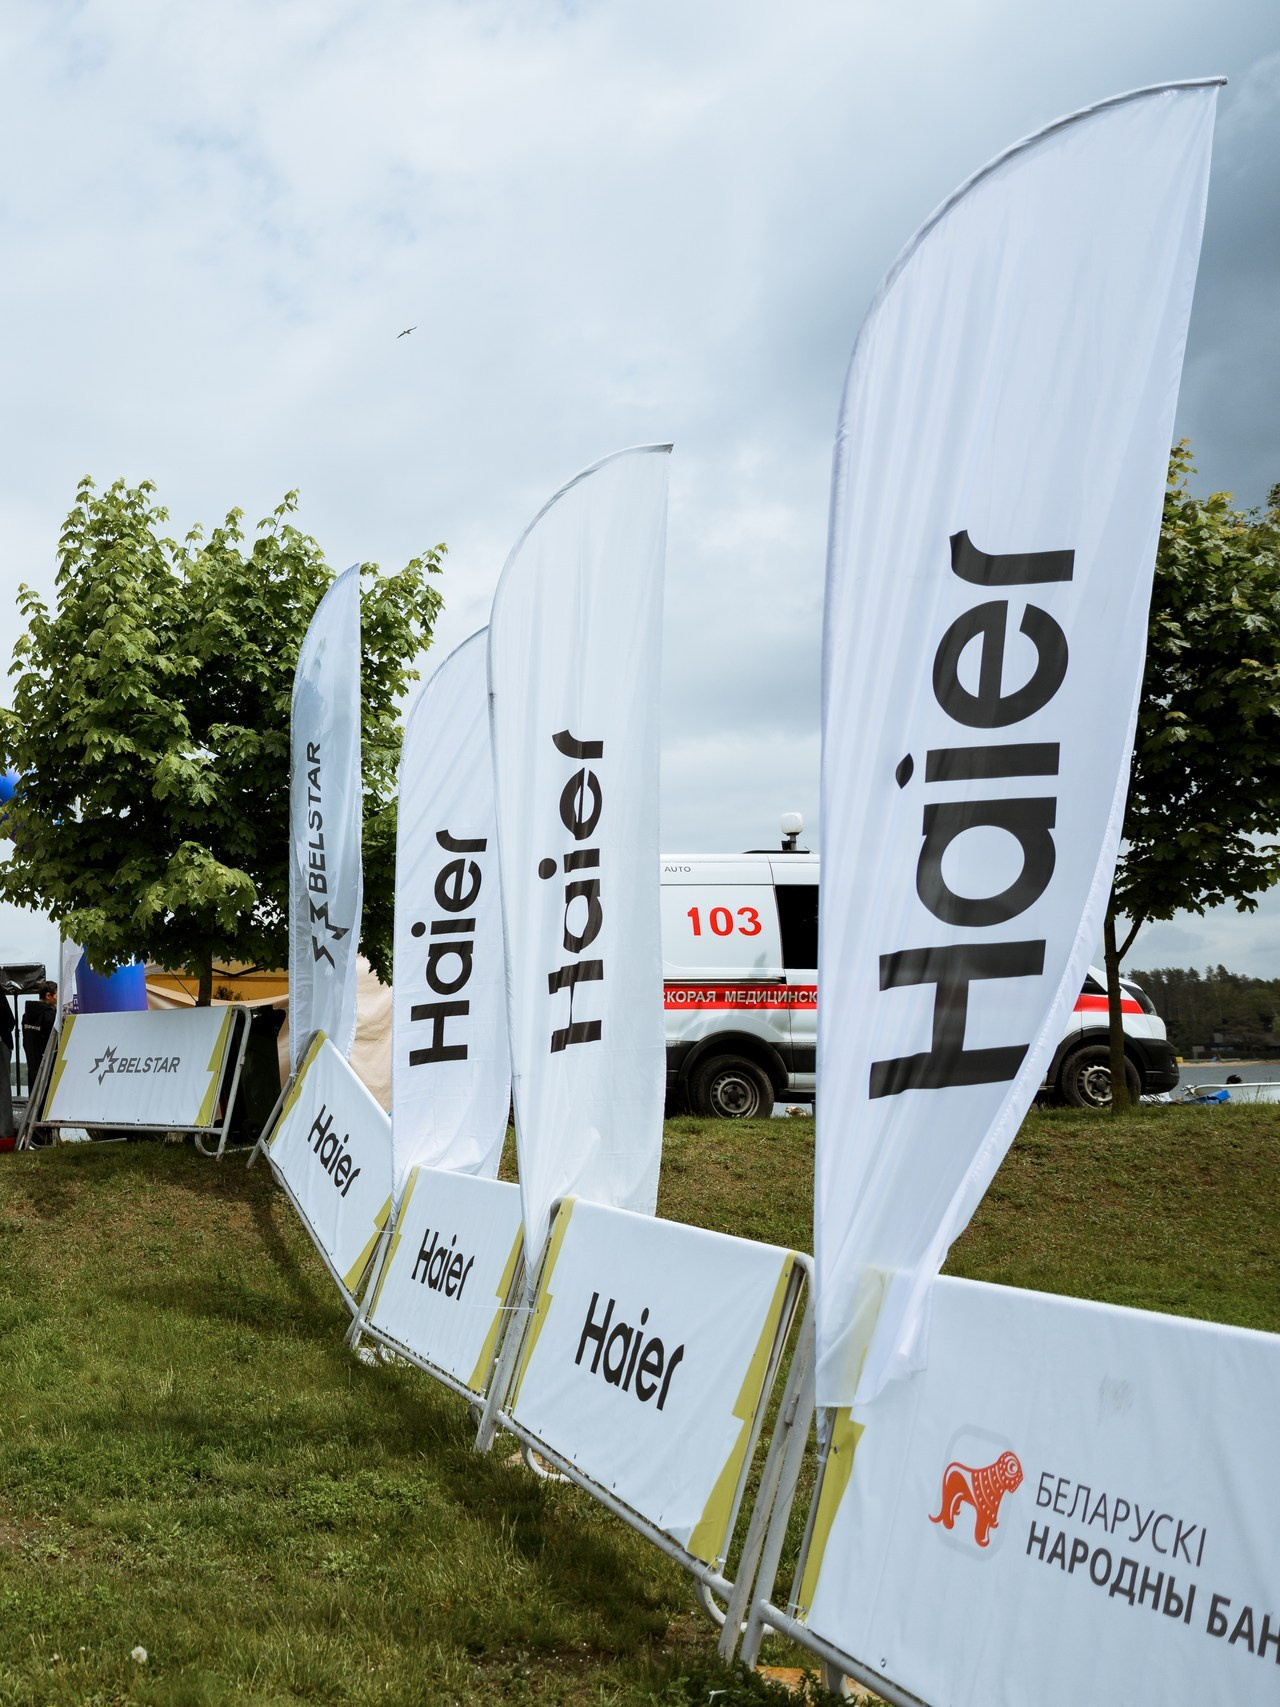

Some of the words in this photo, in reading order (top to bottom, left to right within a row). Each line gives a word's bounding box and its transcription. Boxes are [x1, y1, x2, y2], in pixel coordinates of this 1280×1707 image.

[306, 741, 328, 894] BELSTAR
[869, 529, 1076, 1100] Haier
[538, 729, 604, 1053] Haier
[687, 906, 762, 936] 103
[409, 829, 488, 1067] Haier
[116, 1056, 181, 1074] BELSTAR
[307, 1104, 361, 1198] Haier
[411, 1228, 476, 1301] Haier
[574, 1291, 685, 1412] Haier
[1035, 1471, 1207, 1567] БЕЛАРУСКІ
[1025, 1520, 1196, 1625] НАРОДНЫ
